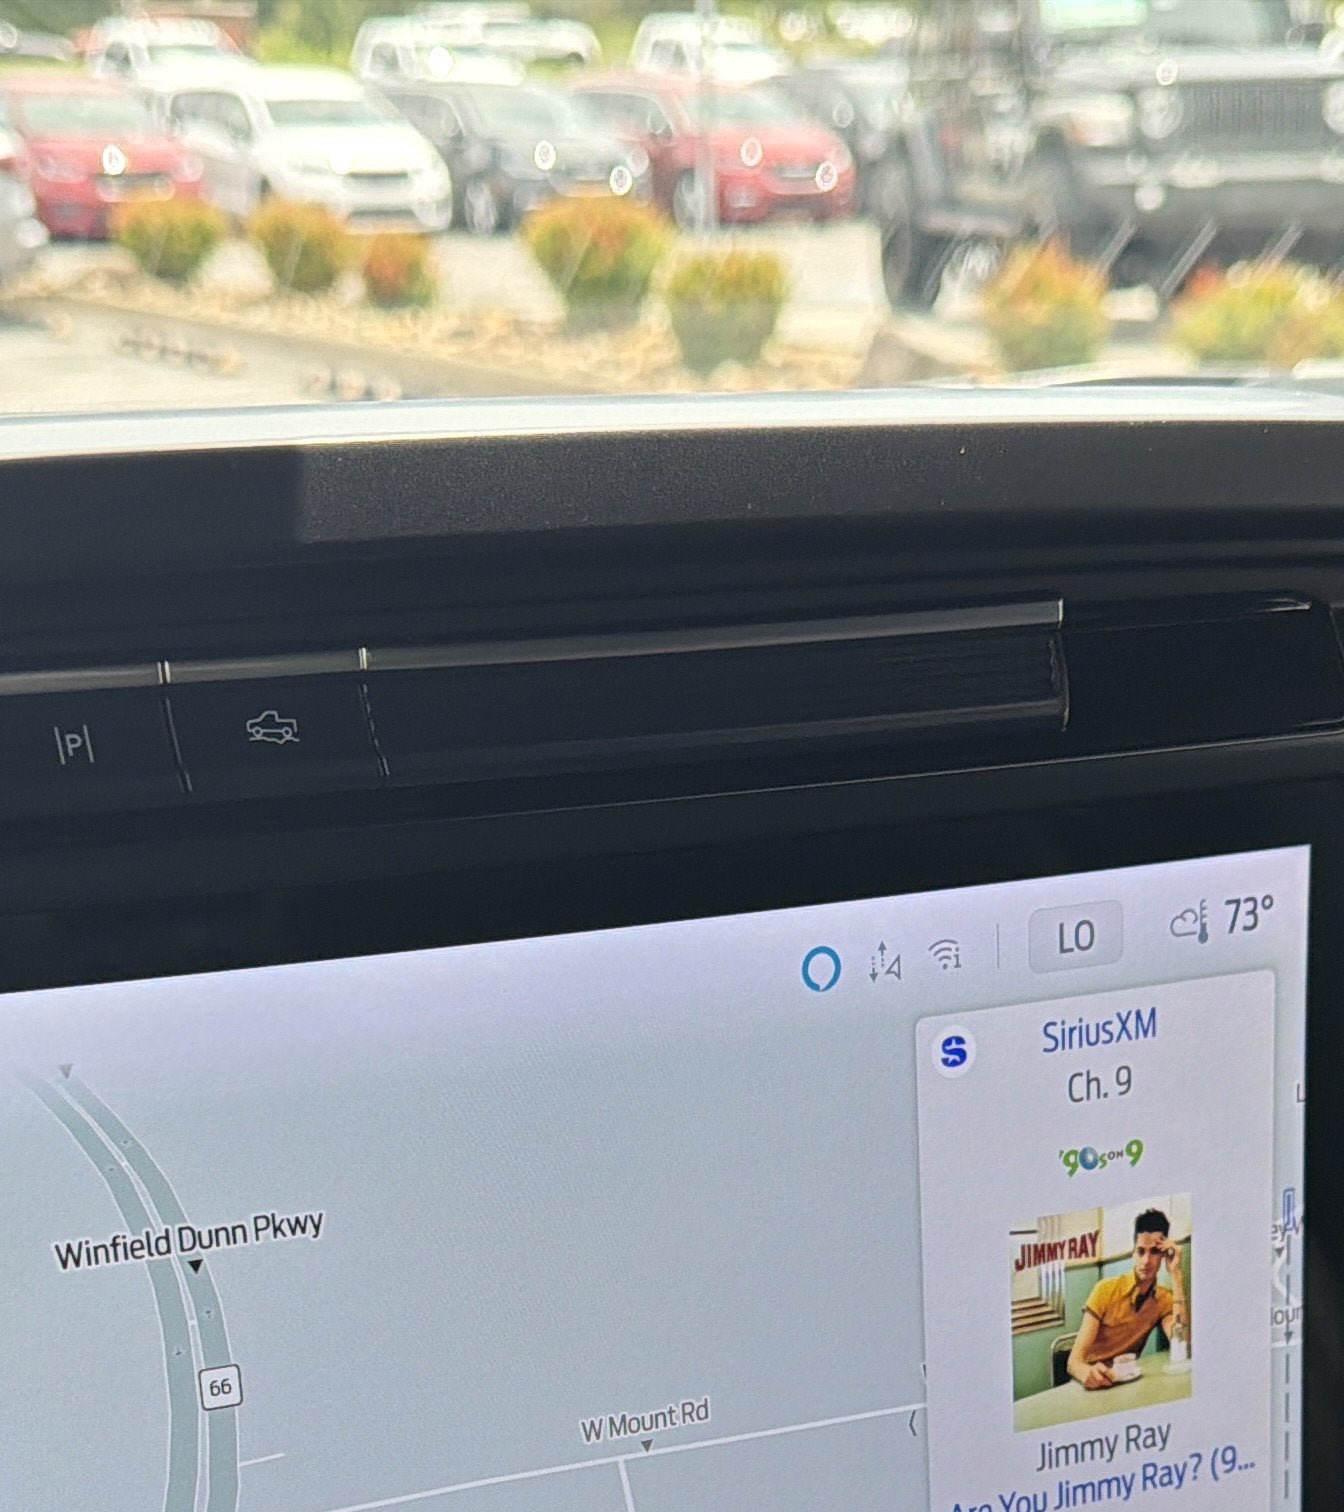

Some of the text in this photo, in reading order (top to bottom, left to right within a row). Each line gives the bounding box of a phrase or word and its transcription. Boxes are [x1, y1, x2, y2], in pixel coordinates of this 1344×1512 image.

[1225, 894, 1274, 934] 73°
[1058, 919, 1095, 954] LO
[1043, 1007, 1157, 1052] SiriusXM
[1068, 1065, 1132, 1102] Ch. 9
[55, 1212, 323, 1270] Winfield Dunn Pkwy
[1014, 1230, 1100, 1271] JIMMY RAY
[209, 1378, 232, 1397] 66
[582, 1398, 710, 1442] W Mount Rd
[1036, 1422, 1172, 1472] Jimmy Ray
[1054, 1473, 1135, 1510] Jimmy
[1142, 1453, 1202, 1492] Ray?
